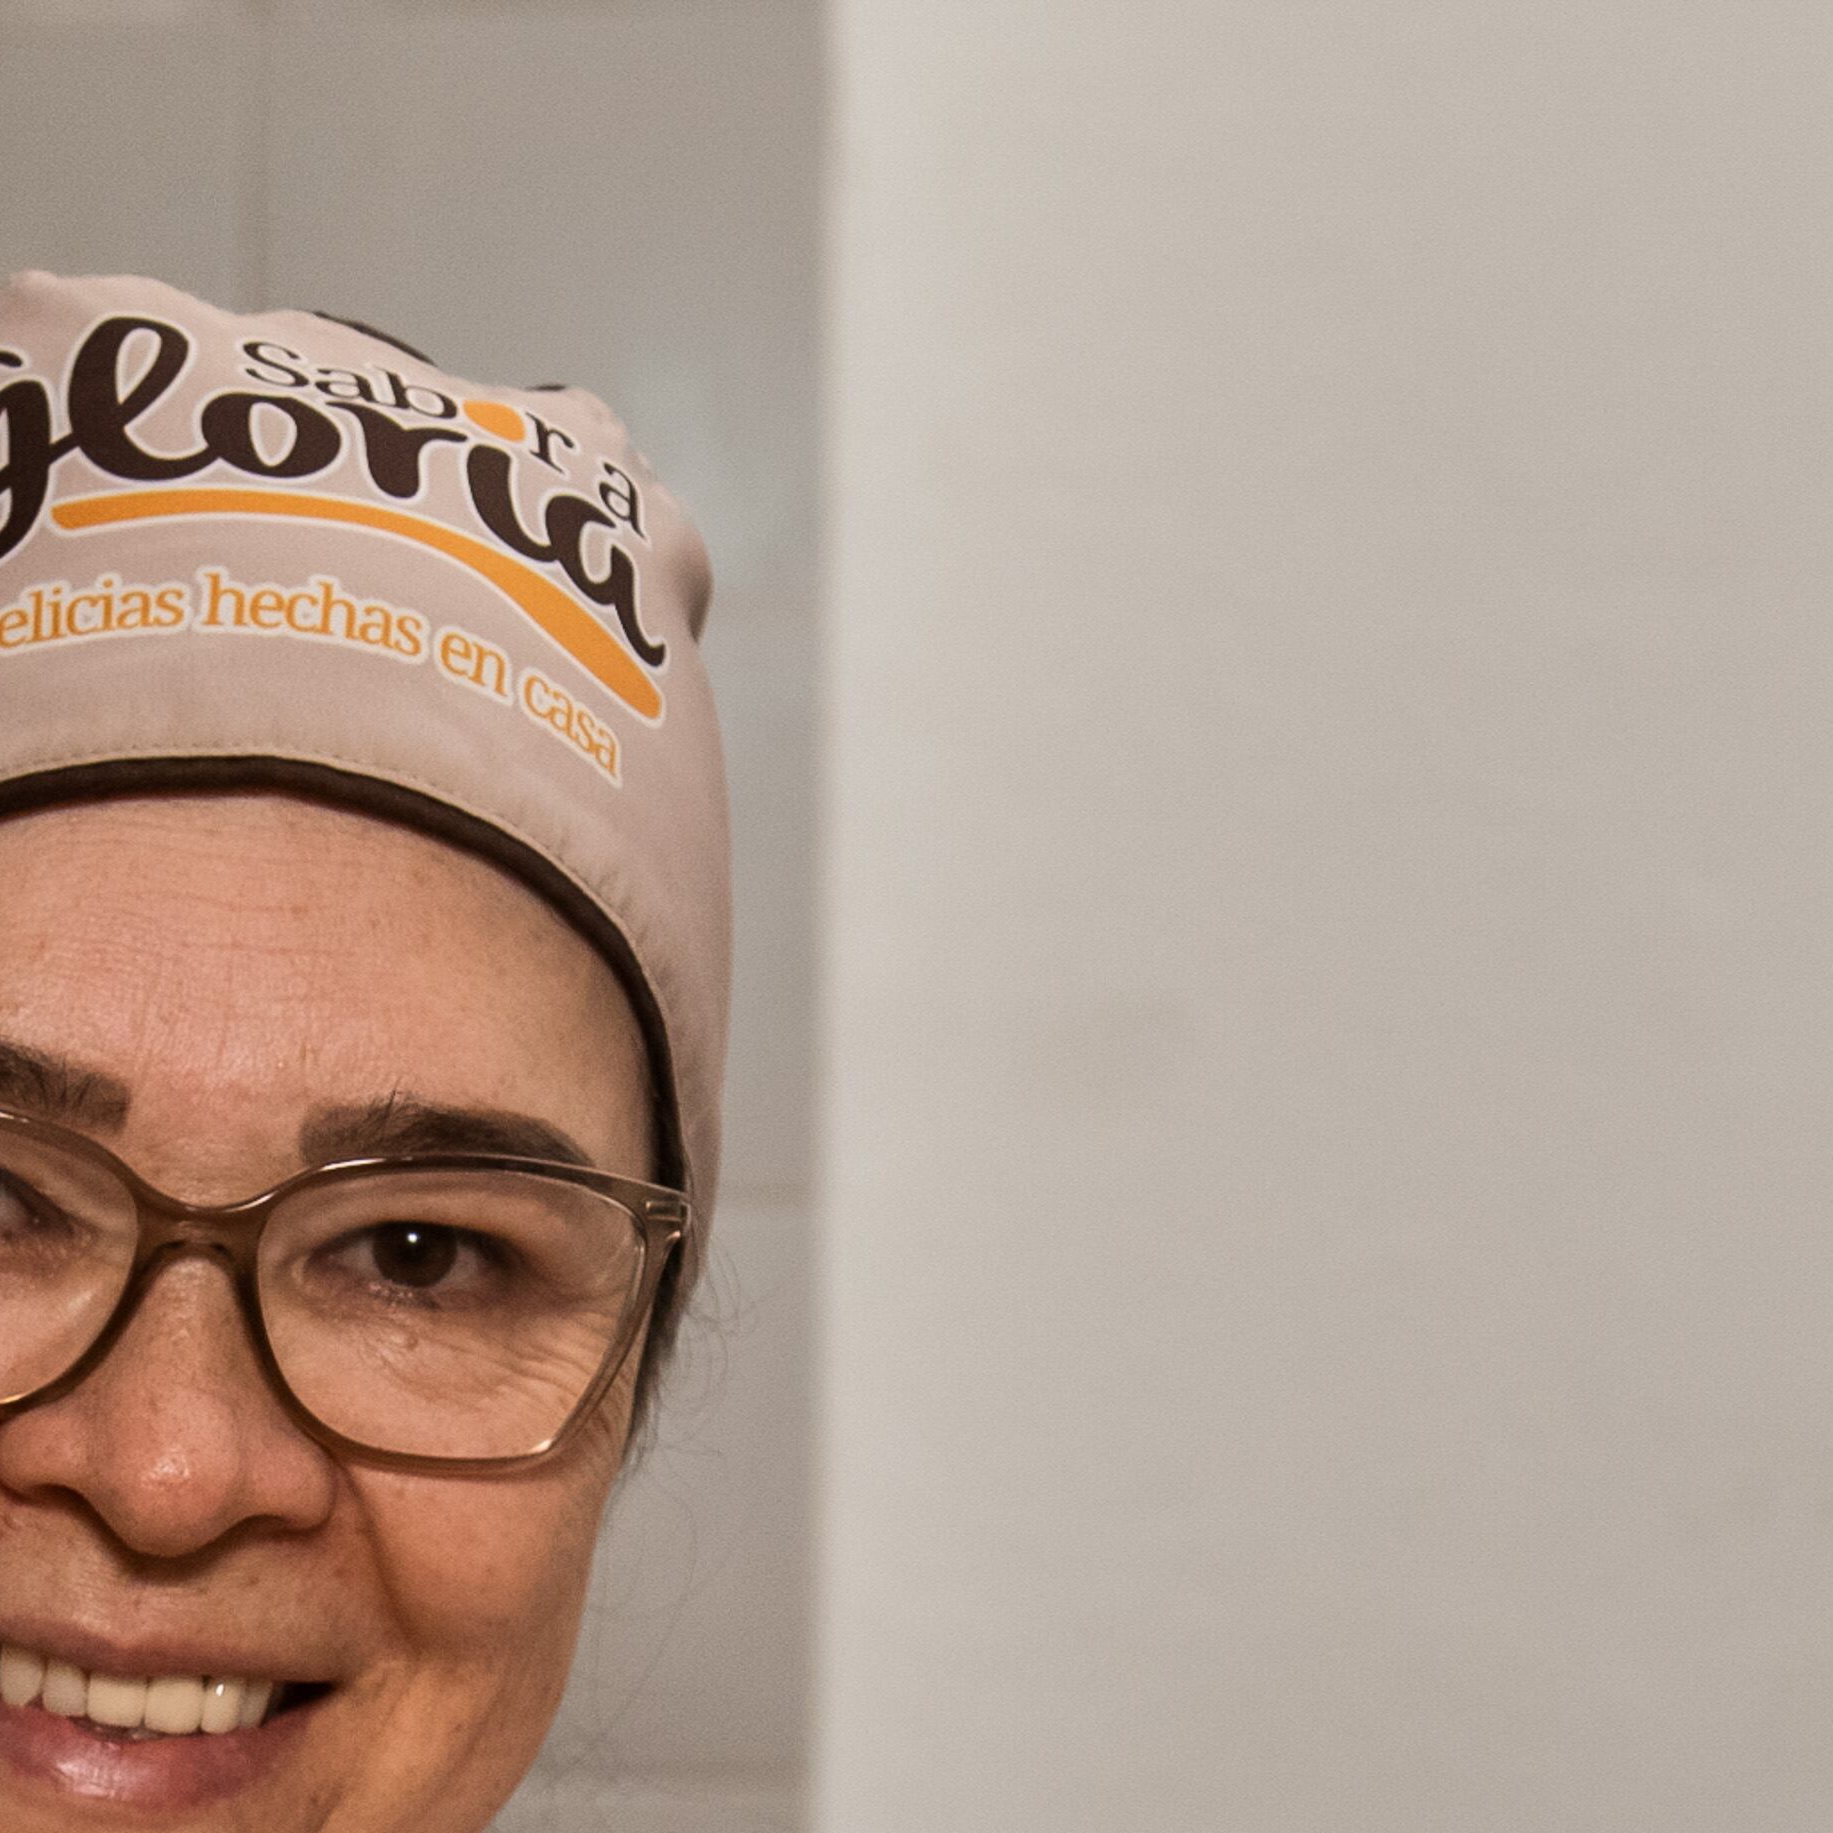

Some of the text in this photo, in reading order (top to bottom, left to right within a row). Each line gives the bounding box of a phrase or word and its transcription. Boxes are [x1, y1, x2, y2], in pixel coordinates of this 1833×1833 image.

[242, 340, 647, 541] Sabor a
[203, 573, 422, 659] hechas
[439, 636, 508, 698] en
[523, 678, 620, 780] casa
